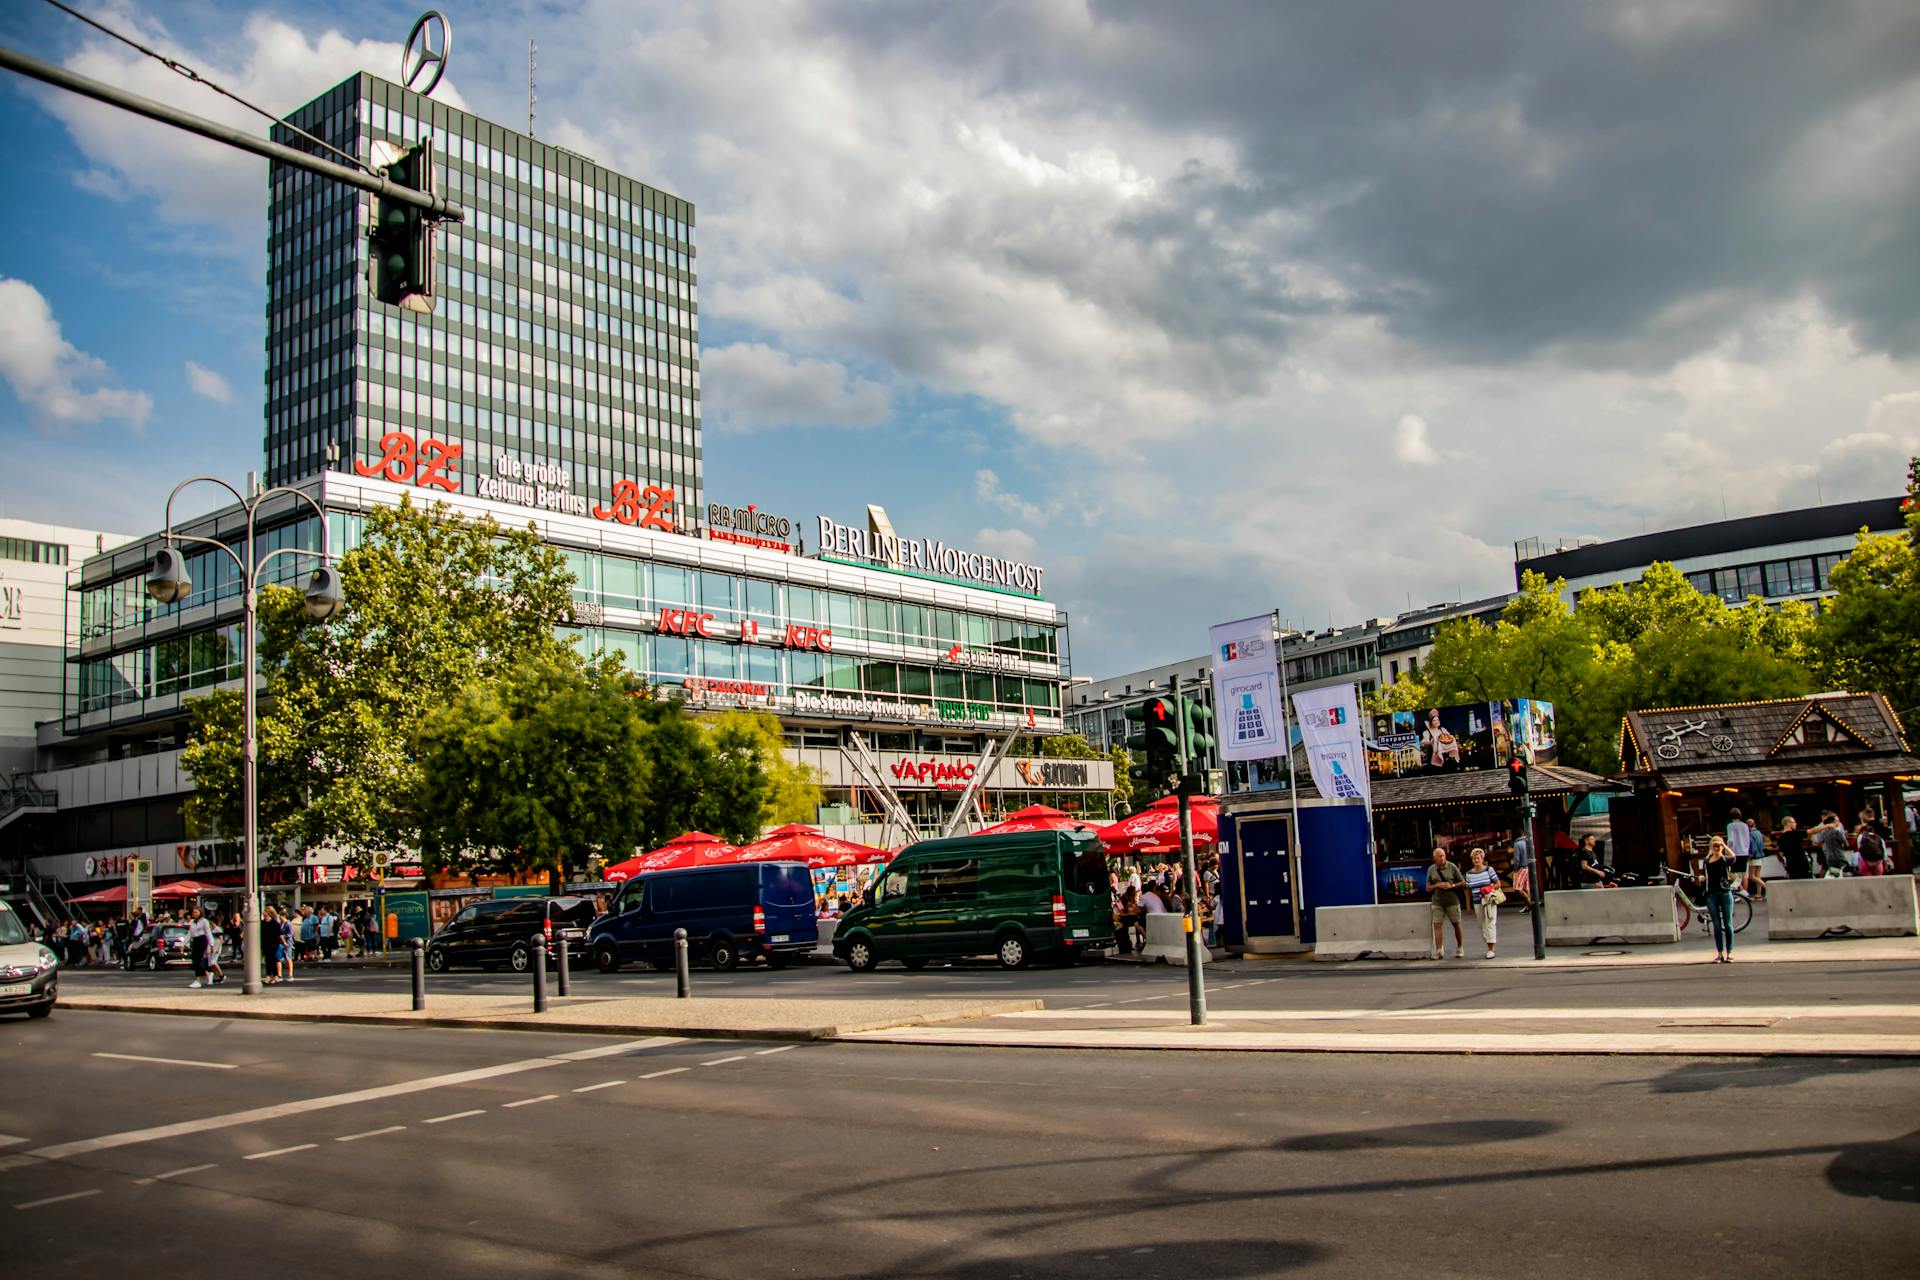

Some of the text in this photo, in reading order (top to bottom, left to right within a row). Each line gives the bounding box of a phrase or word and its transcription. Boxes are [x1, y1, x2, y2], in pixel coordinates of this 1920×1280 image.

[497, 454, 571, 488] die größte
[478, 473, 587, 514] Zeitung Berlins
[817, 515, 1044, 592] BERLINER MORGENPOST
[657, 607, 716, 637] KFC
[784, 623, 832, 651] KFC
[795, 690, 819, 709] Die
[819, 693, 921, 716] Stachelschweine
[1230, 681, 1263, 697] girocard
[891, 751, 976, 783] VAPIANO
[1041, 761, 1089, 788] SATURN
[263, 869, 289, 884] KFC
[342, 865, 382, 882] KC
